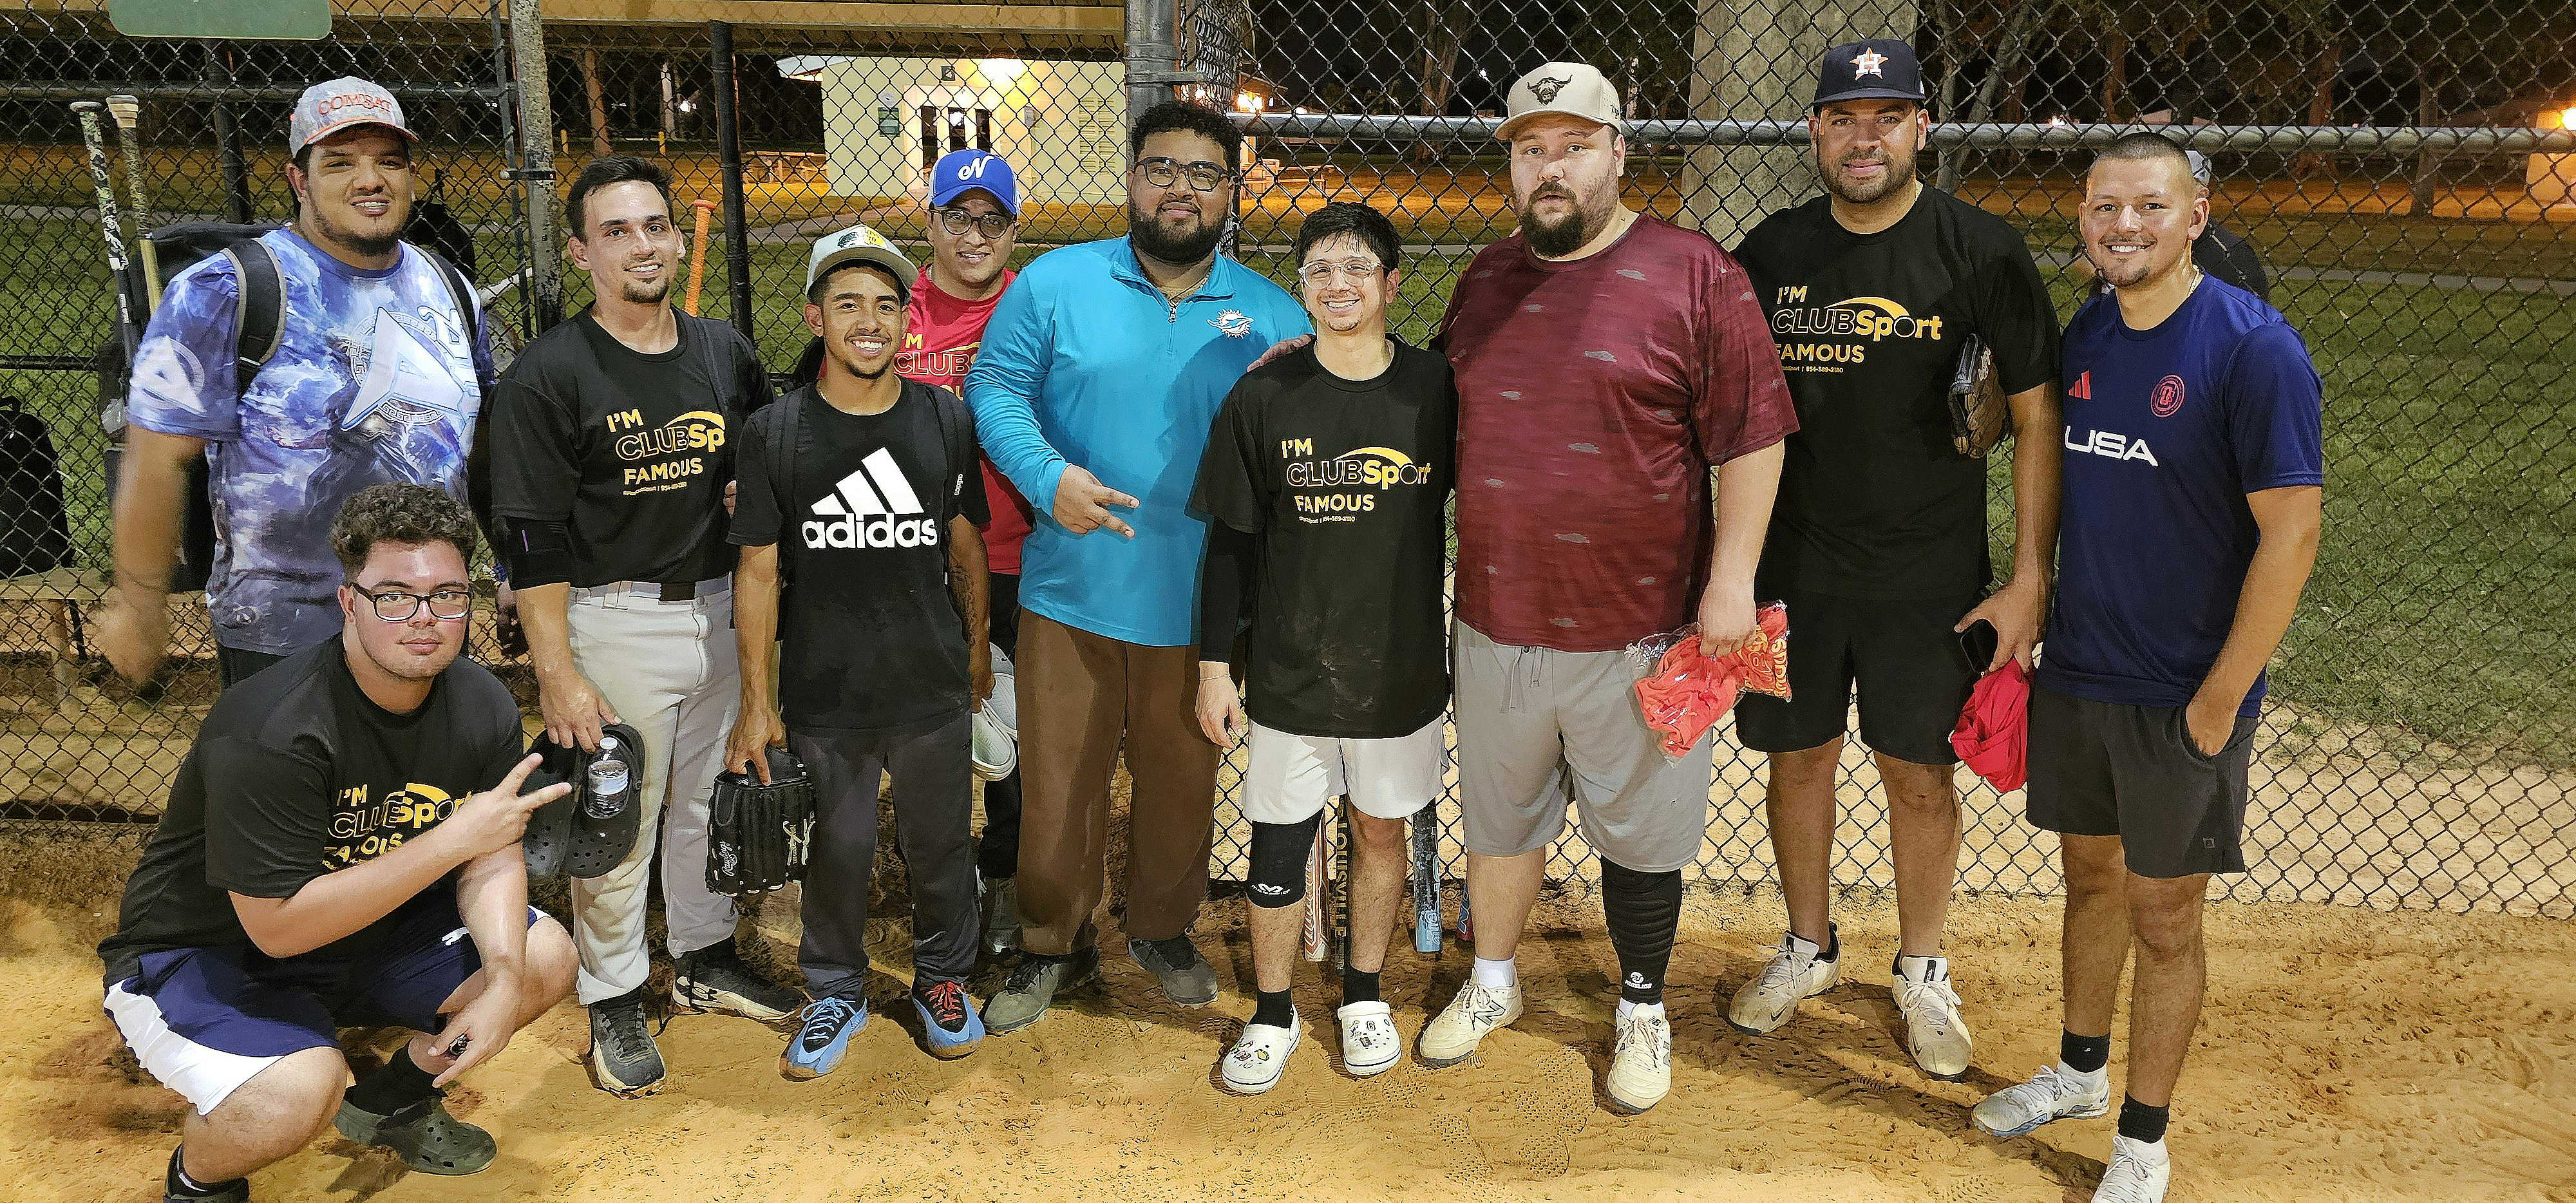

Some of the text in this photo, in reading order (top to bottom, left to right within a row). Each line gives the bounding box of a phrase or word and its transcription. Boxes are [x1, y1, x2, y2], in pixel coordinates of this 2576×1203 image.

[1855, 52, 1882, 75] H
[958, 155, 994, 181] N
[1777, 285, 1808, 305] I'M
[1772, 308, 1942, 342] CLUBSport
[902, 332, 923, 350] 'M
[606, 408, 643, 433] I'M
[615, 422, 726, 460] CLUBSp
[1281, 437, 1312, 459] I'M
[2065, 425, 2159, 467] USA
[623, 457, 704, 486] FAMOUS
[1286, 459, 1432, 491] CLUBSport
[1294, 493, 1376, 513] FAMOUS
[802, 512, 938, 549] adidas
